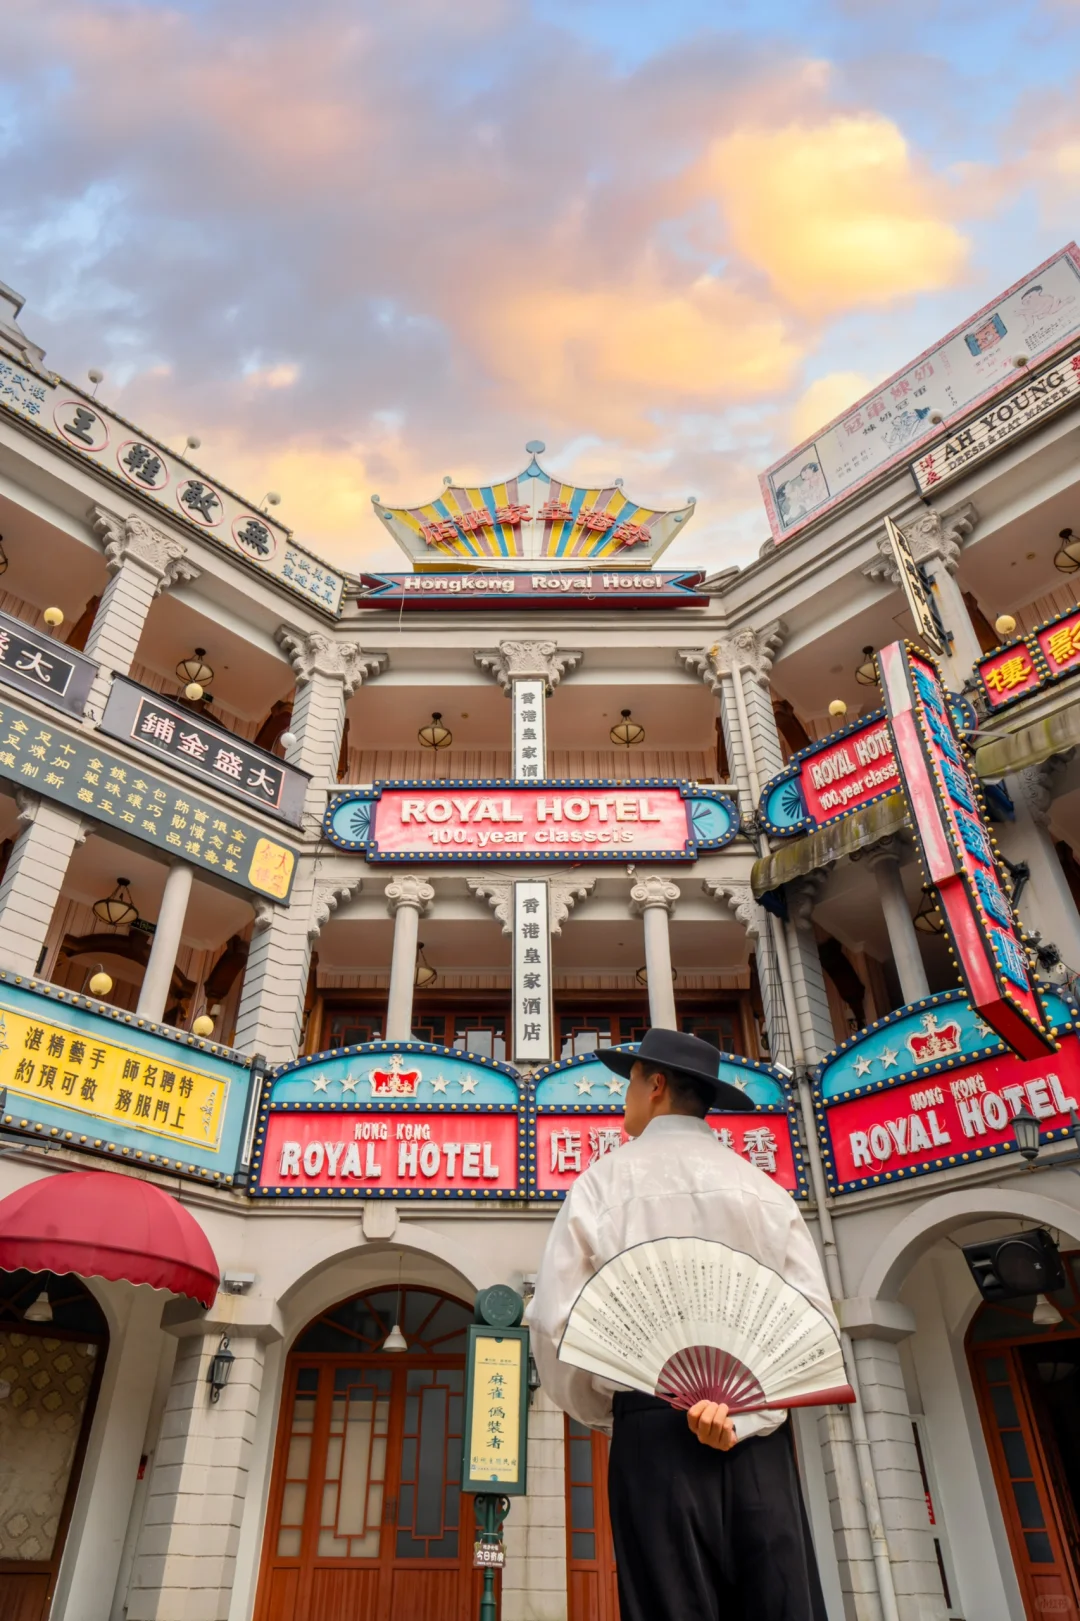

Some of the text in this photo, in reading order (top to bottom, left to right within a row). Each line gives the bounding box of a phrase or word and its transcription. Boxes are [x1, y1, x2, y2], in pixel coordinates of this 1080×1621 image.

[944, 428, 976, 461] AH
[980, 370, 1067, 433] YOUNG
[948, 386, 1072, 471] DRESS & HAT MAKER
[404, 573, 663, 596] Hongkong Royal Hotel
[808, 748, 857, 791] ROYAL
[400, 797, 661, 824] ROYAL HOTEL
[838, 780, 865, 806] year
[477, 829, 527, 848] year
[534, 826, 634, 844] classcis
[520, 897, 542, 1042] 香港皇家酒店
[909, 1072, 987, 1112] HONG KONG
[354, 1122, 431, 1141] HONG KONG
[848, 1073, 1078, 1168] ROYAL HOTEL
[279, 1141, 500, 1178] ROYAL HOTEL
